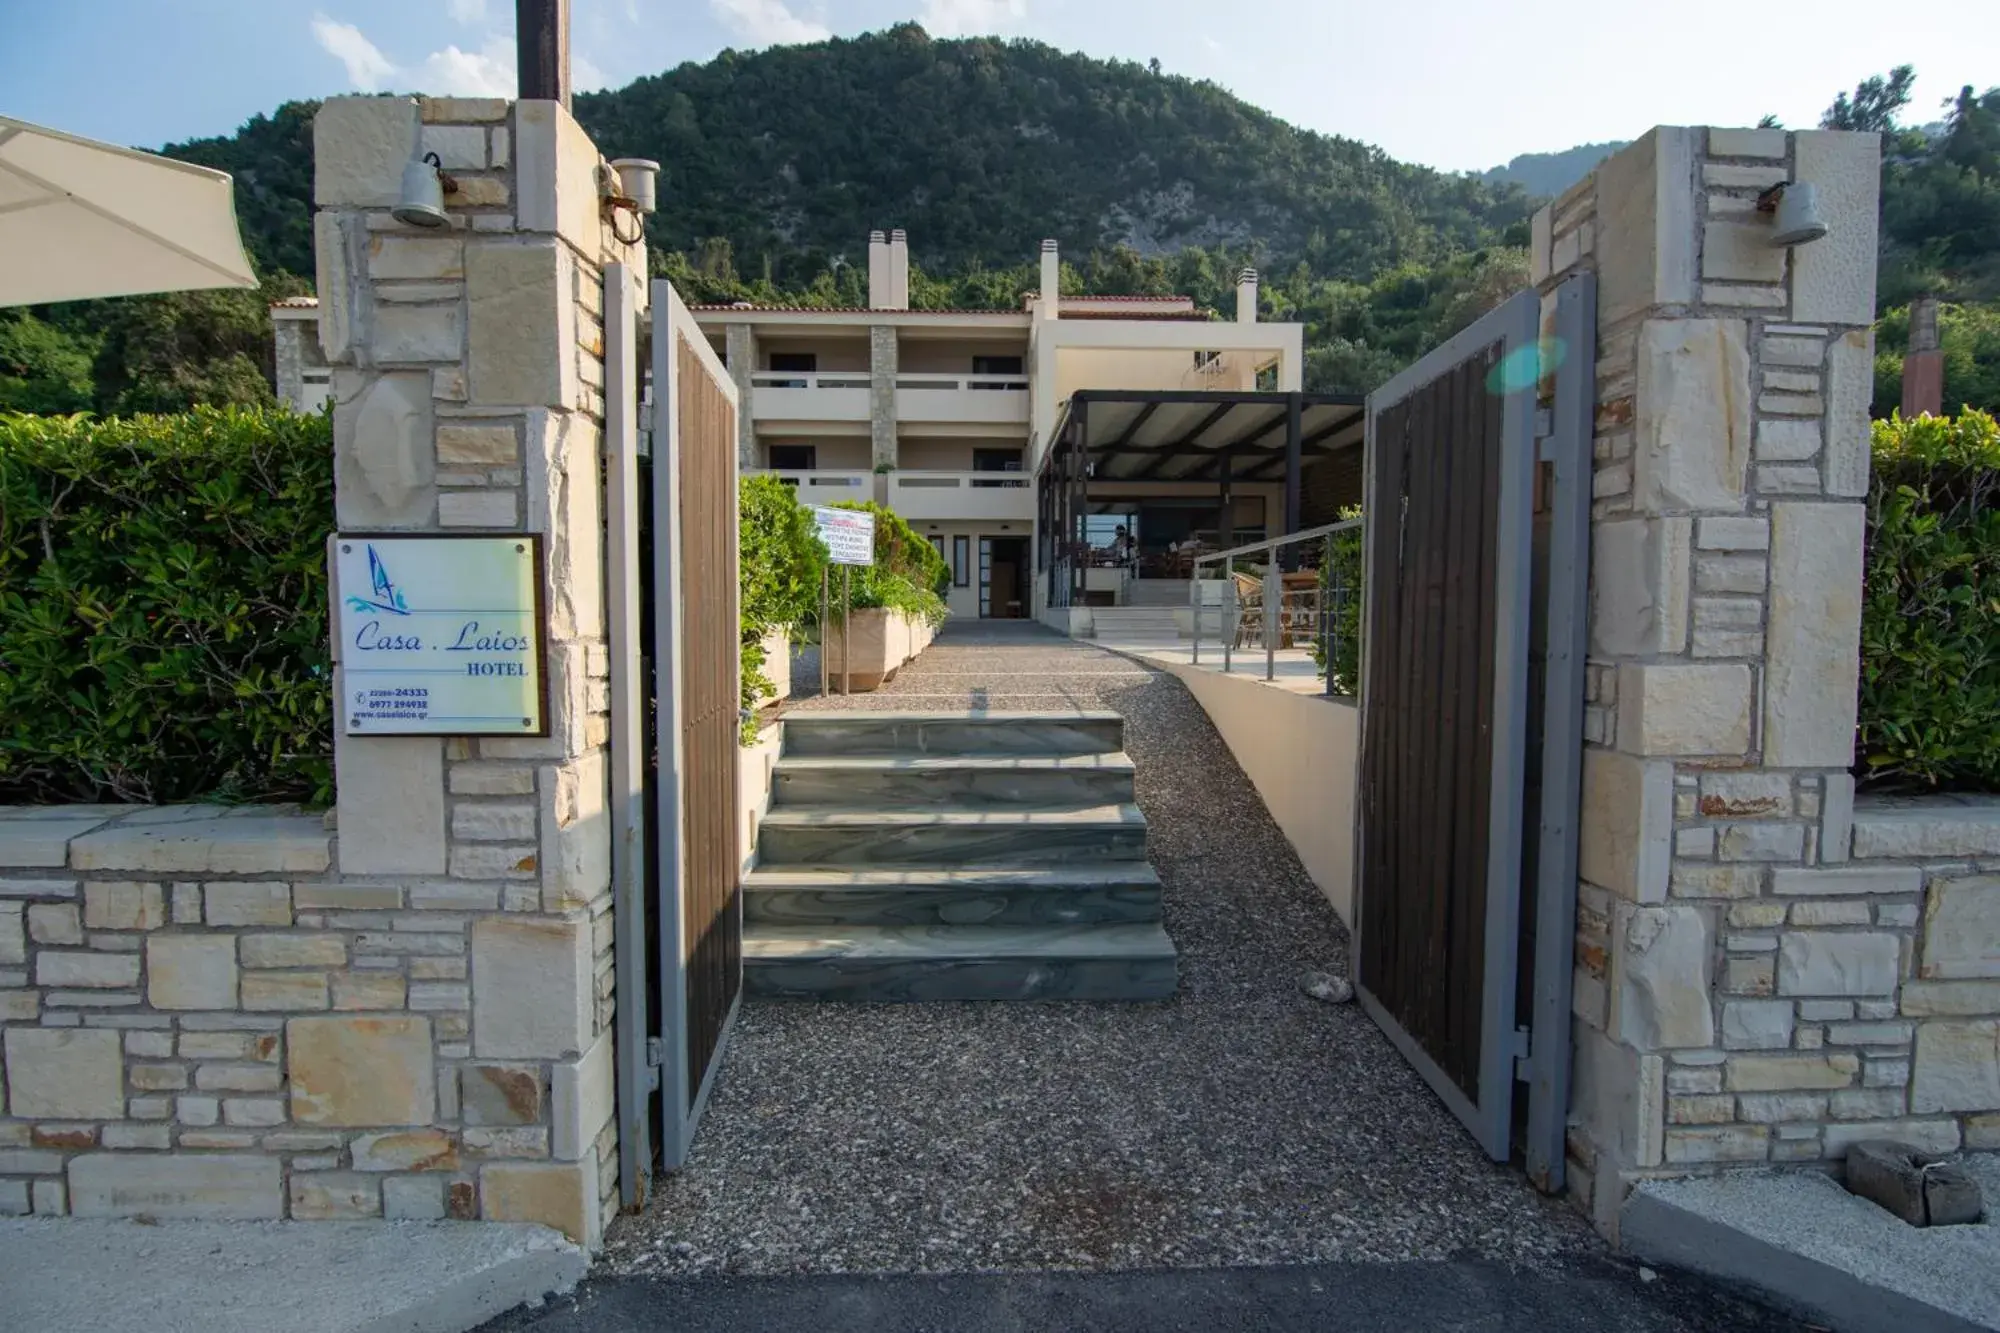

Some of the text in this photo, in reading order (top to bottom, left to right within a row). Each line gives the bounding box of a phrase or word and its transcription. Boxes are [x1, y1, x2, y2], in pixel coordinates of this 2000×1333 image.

[355, 620, 421, 651] Casa
[445, 620, 529, 651] Laios
[467, 662, 529, 677] HOTEL
